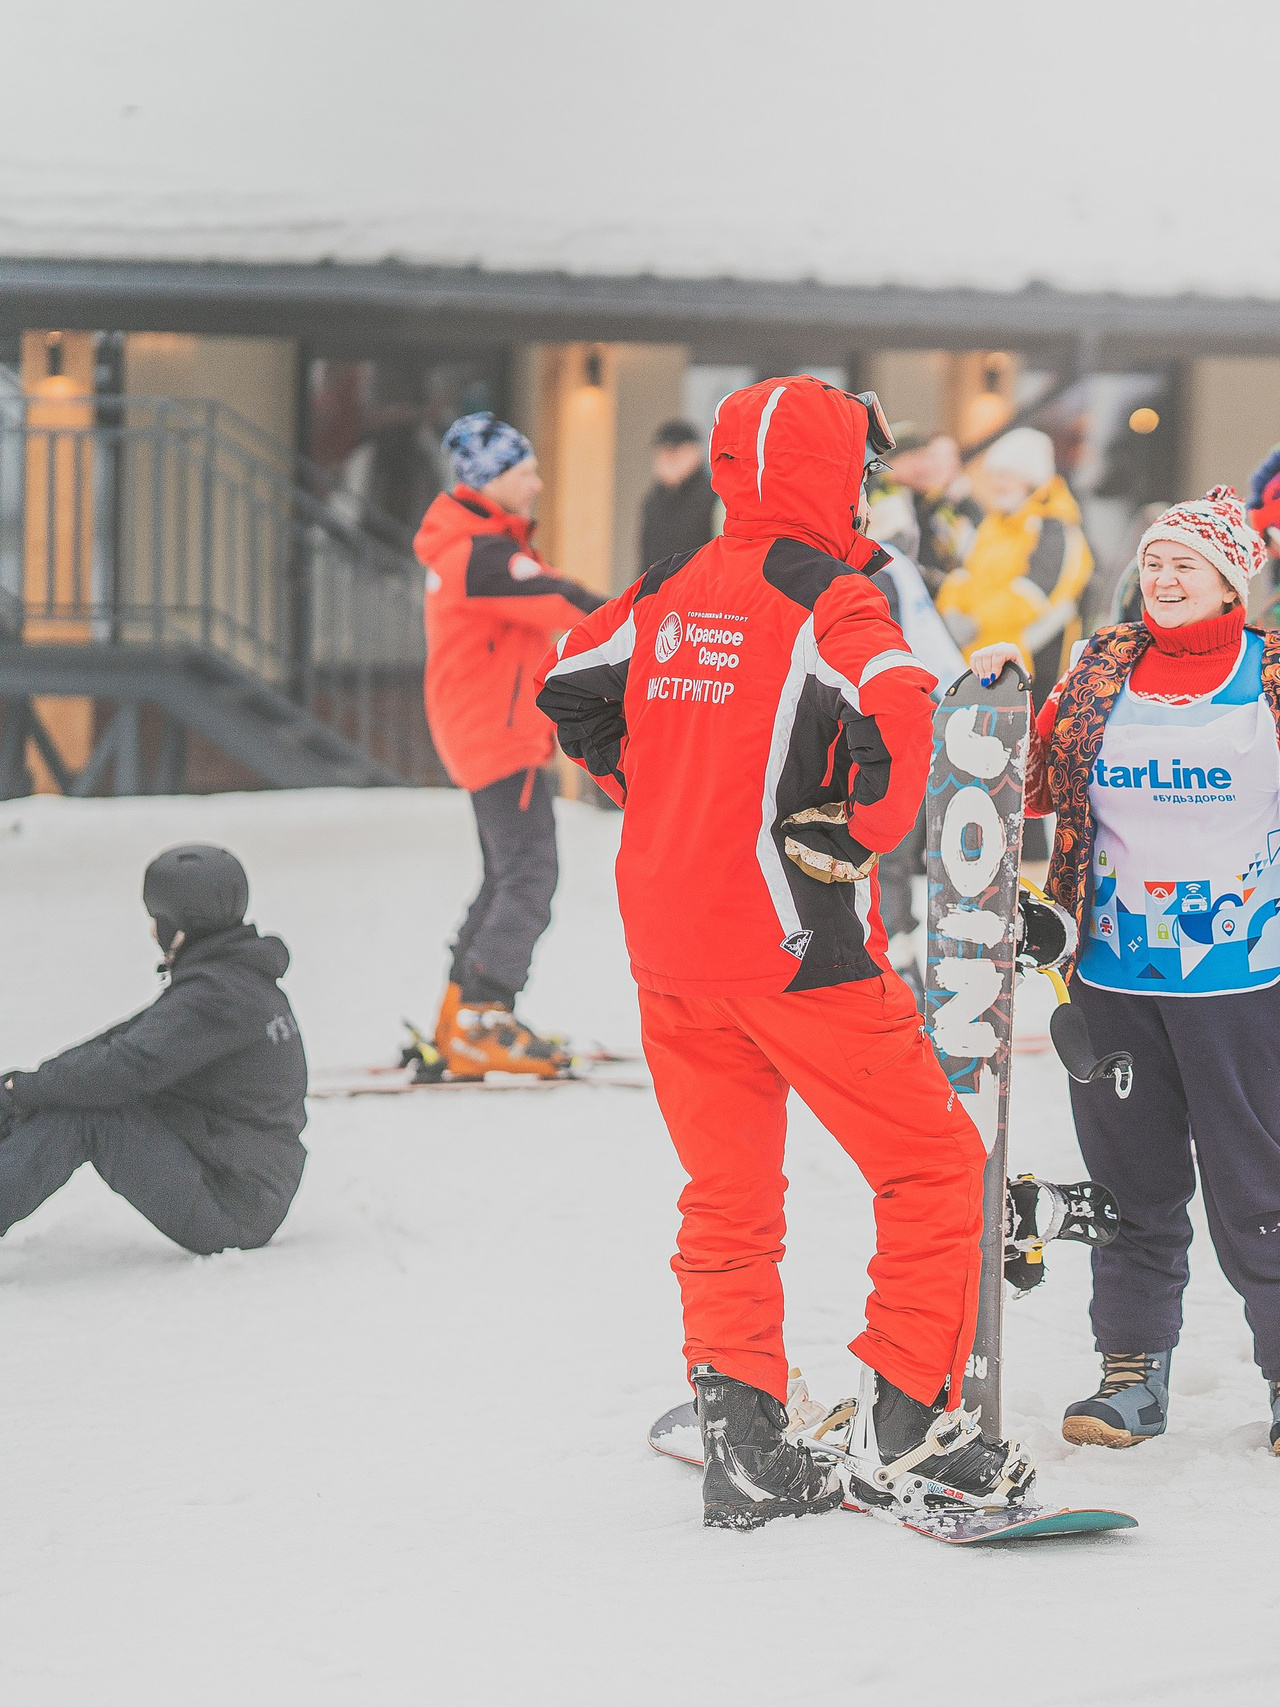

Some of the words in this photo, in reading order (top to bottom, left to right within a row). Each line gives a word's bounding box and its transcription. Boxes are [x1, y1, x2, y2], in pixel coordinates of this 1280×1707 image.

[724, 614, 749, 622] КУРОРТ
[685, 623, 744, 647] Красное
[698, 646, 740, 672] Озеро
[1152, 793, 1237, 805] #БУДЬЗДОРОВ!
